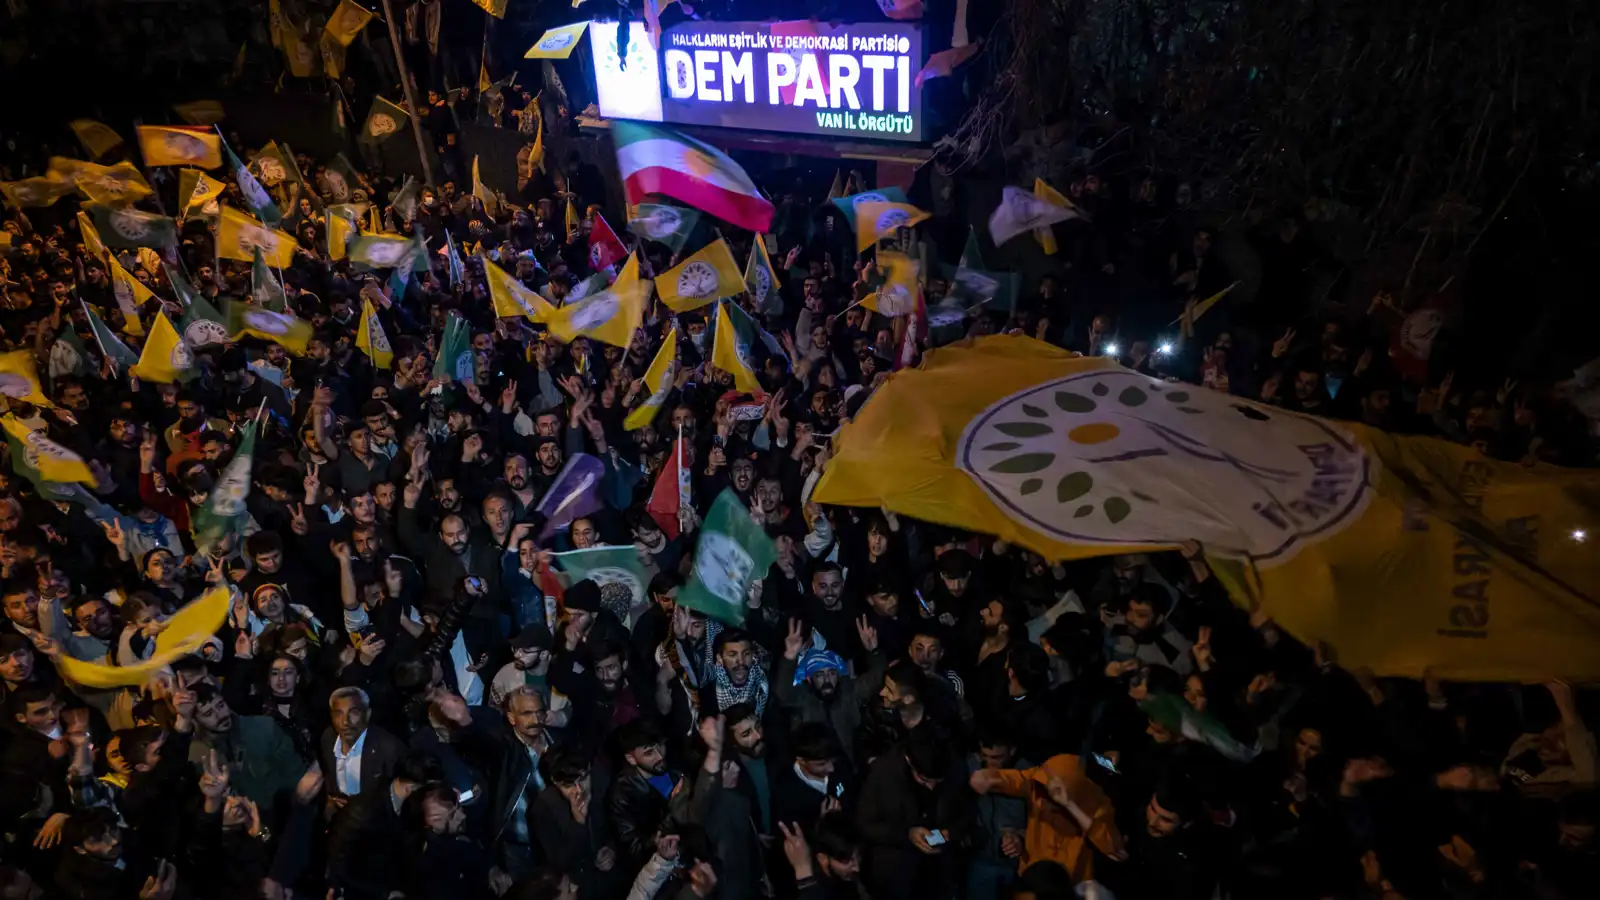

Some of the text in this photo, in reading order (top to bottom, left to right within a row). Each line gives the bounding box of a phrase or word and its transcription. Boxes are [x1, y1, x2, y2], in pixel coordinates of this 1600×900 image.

[672, 31, 899, 52] HALKLARIN EŞİTLİK VE DEMOKRASİ PARTİSİ
[665, 37, 910, 113] DEM PARTİ
[816, 111, 913, 134] VAN İL ÖRGÜTÜ
